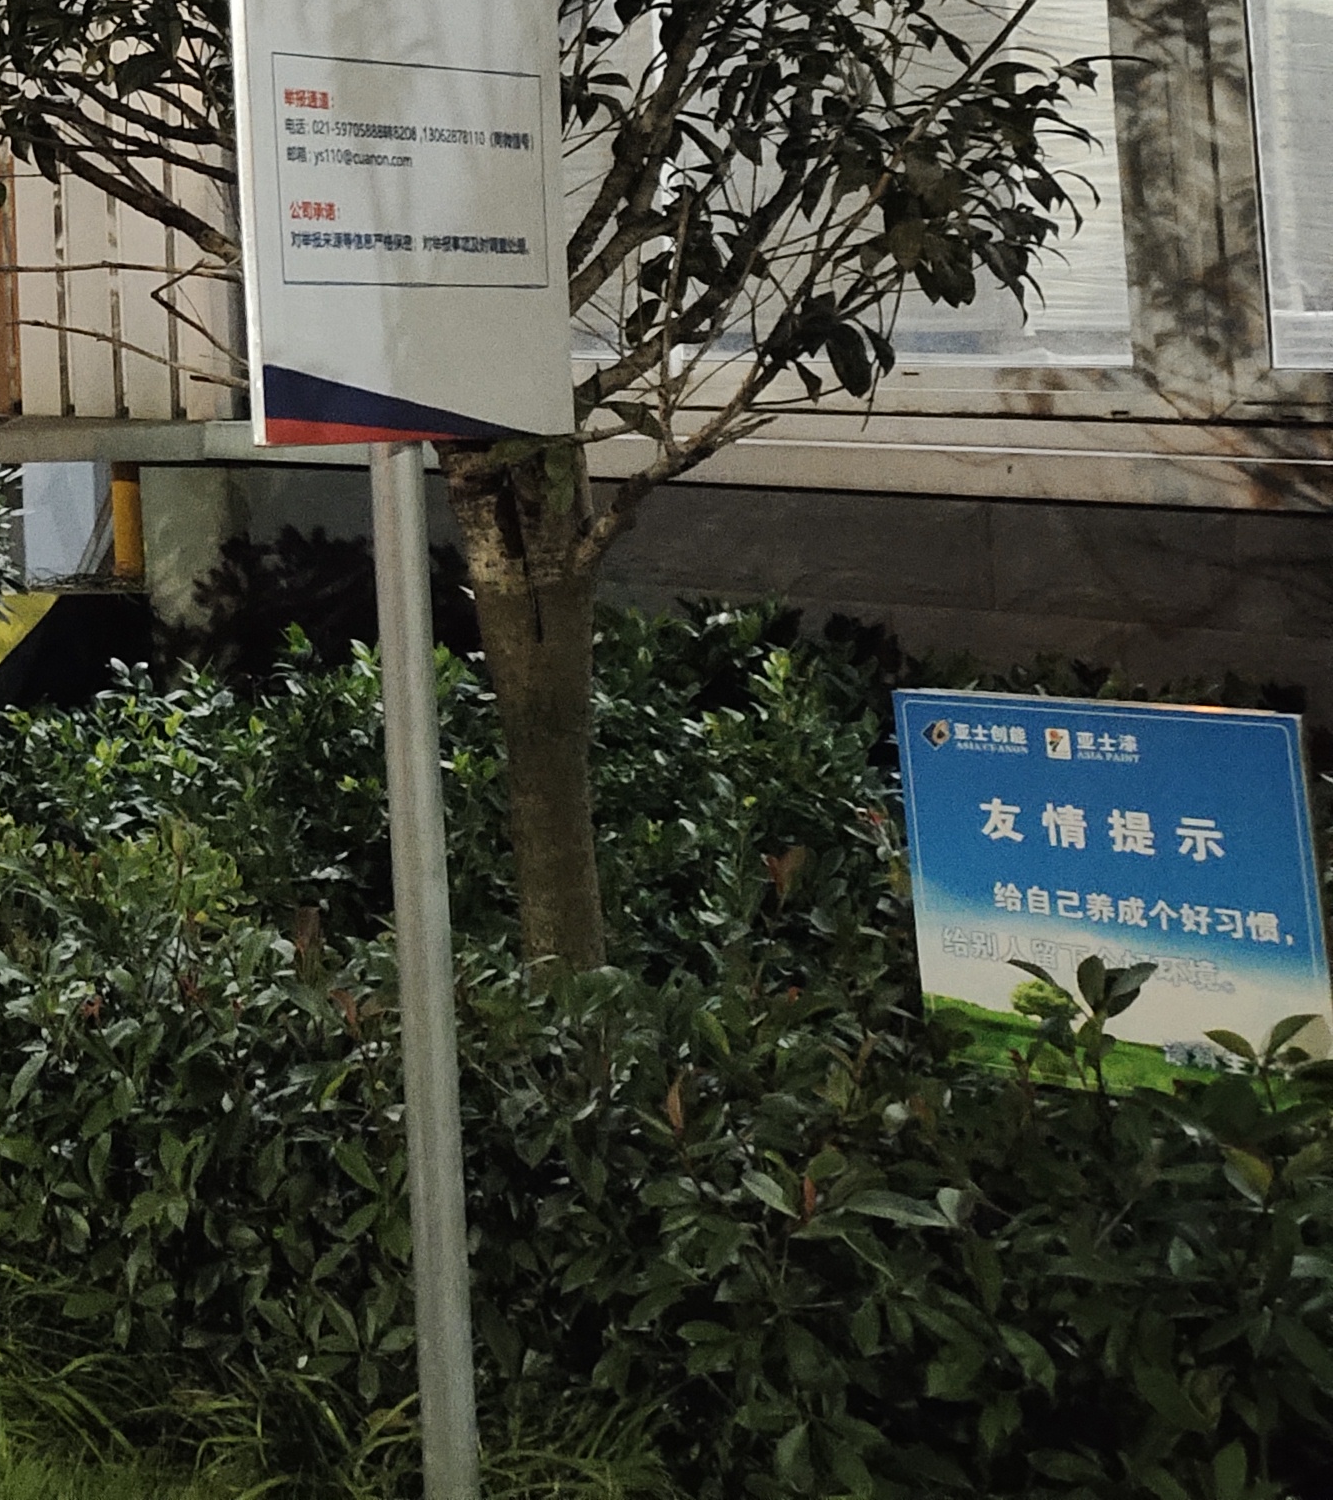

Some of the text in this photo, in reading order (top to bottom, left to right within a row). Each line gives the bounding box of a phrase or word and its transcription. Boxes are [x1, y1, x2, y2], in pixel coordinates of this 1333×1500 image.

[953, 722, 1028, 745] 亚士创能
[1076, 731, 1139, 753] 亚士漆
[979, 797, 1226, 862] 友情提示
[993, 881, 1296, 946] 给自己养成个好习惯，
